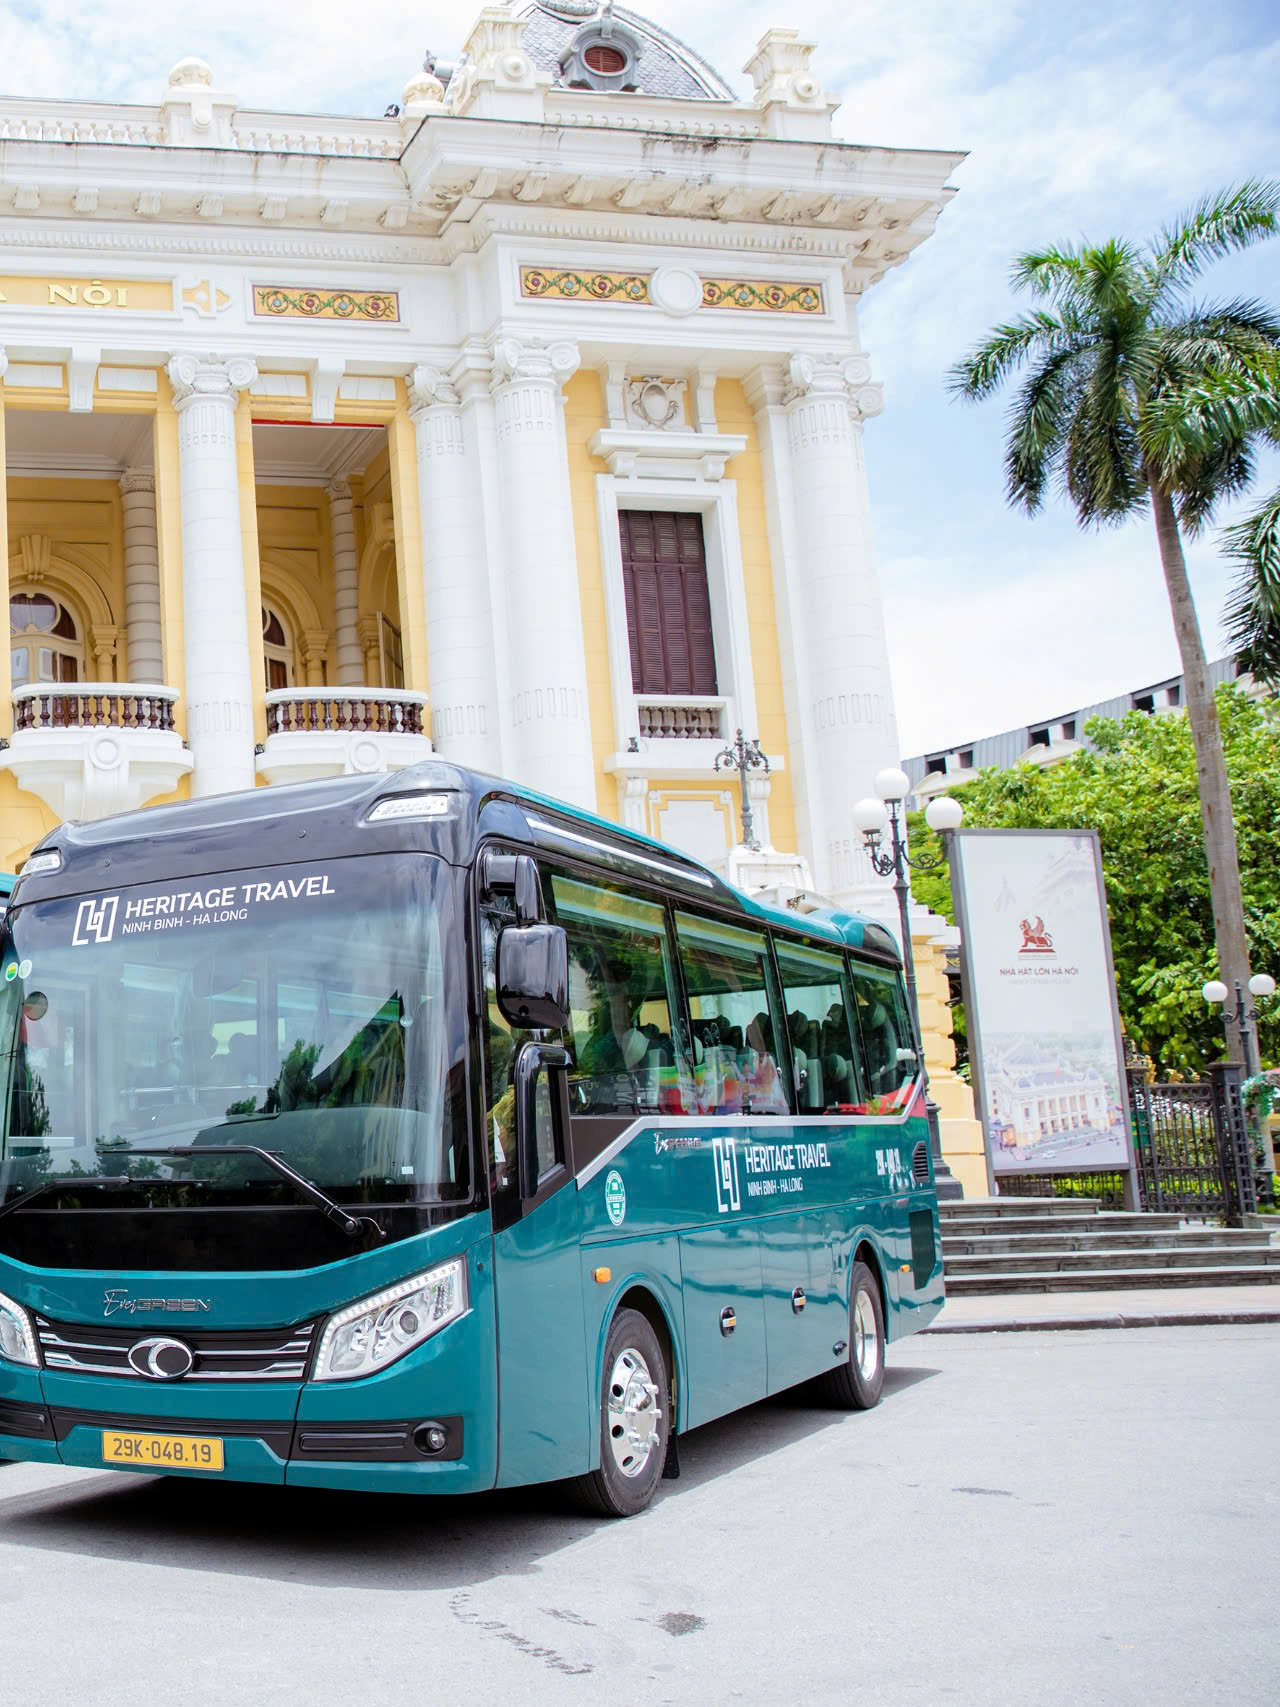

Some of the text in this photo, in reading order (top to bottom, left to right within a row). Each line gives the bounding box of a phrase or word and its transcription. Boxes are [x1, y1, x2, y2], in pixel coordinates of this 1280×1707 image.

[48, 279, 128, 309] NỘI
[125, 875, 336, 919] HERITAGE TRAVEL
[122, 920, 151, 934] NINH
[154, 916, 183, 930] BINH
[192, 913, 210, 925] HA
[213, 908, 248, 923] LONG
[744, 1142, 831, 1174] HERITAGE TRAVEL
[747, 1181, 763, 1197] NINH
[762, 1179, 777, 1196] BINH
[779, 1178, 789, 1193] HA
[788, 1176, 804, 1193] LONG
[113, 1437, 212, 1463] 29K-048.19
